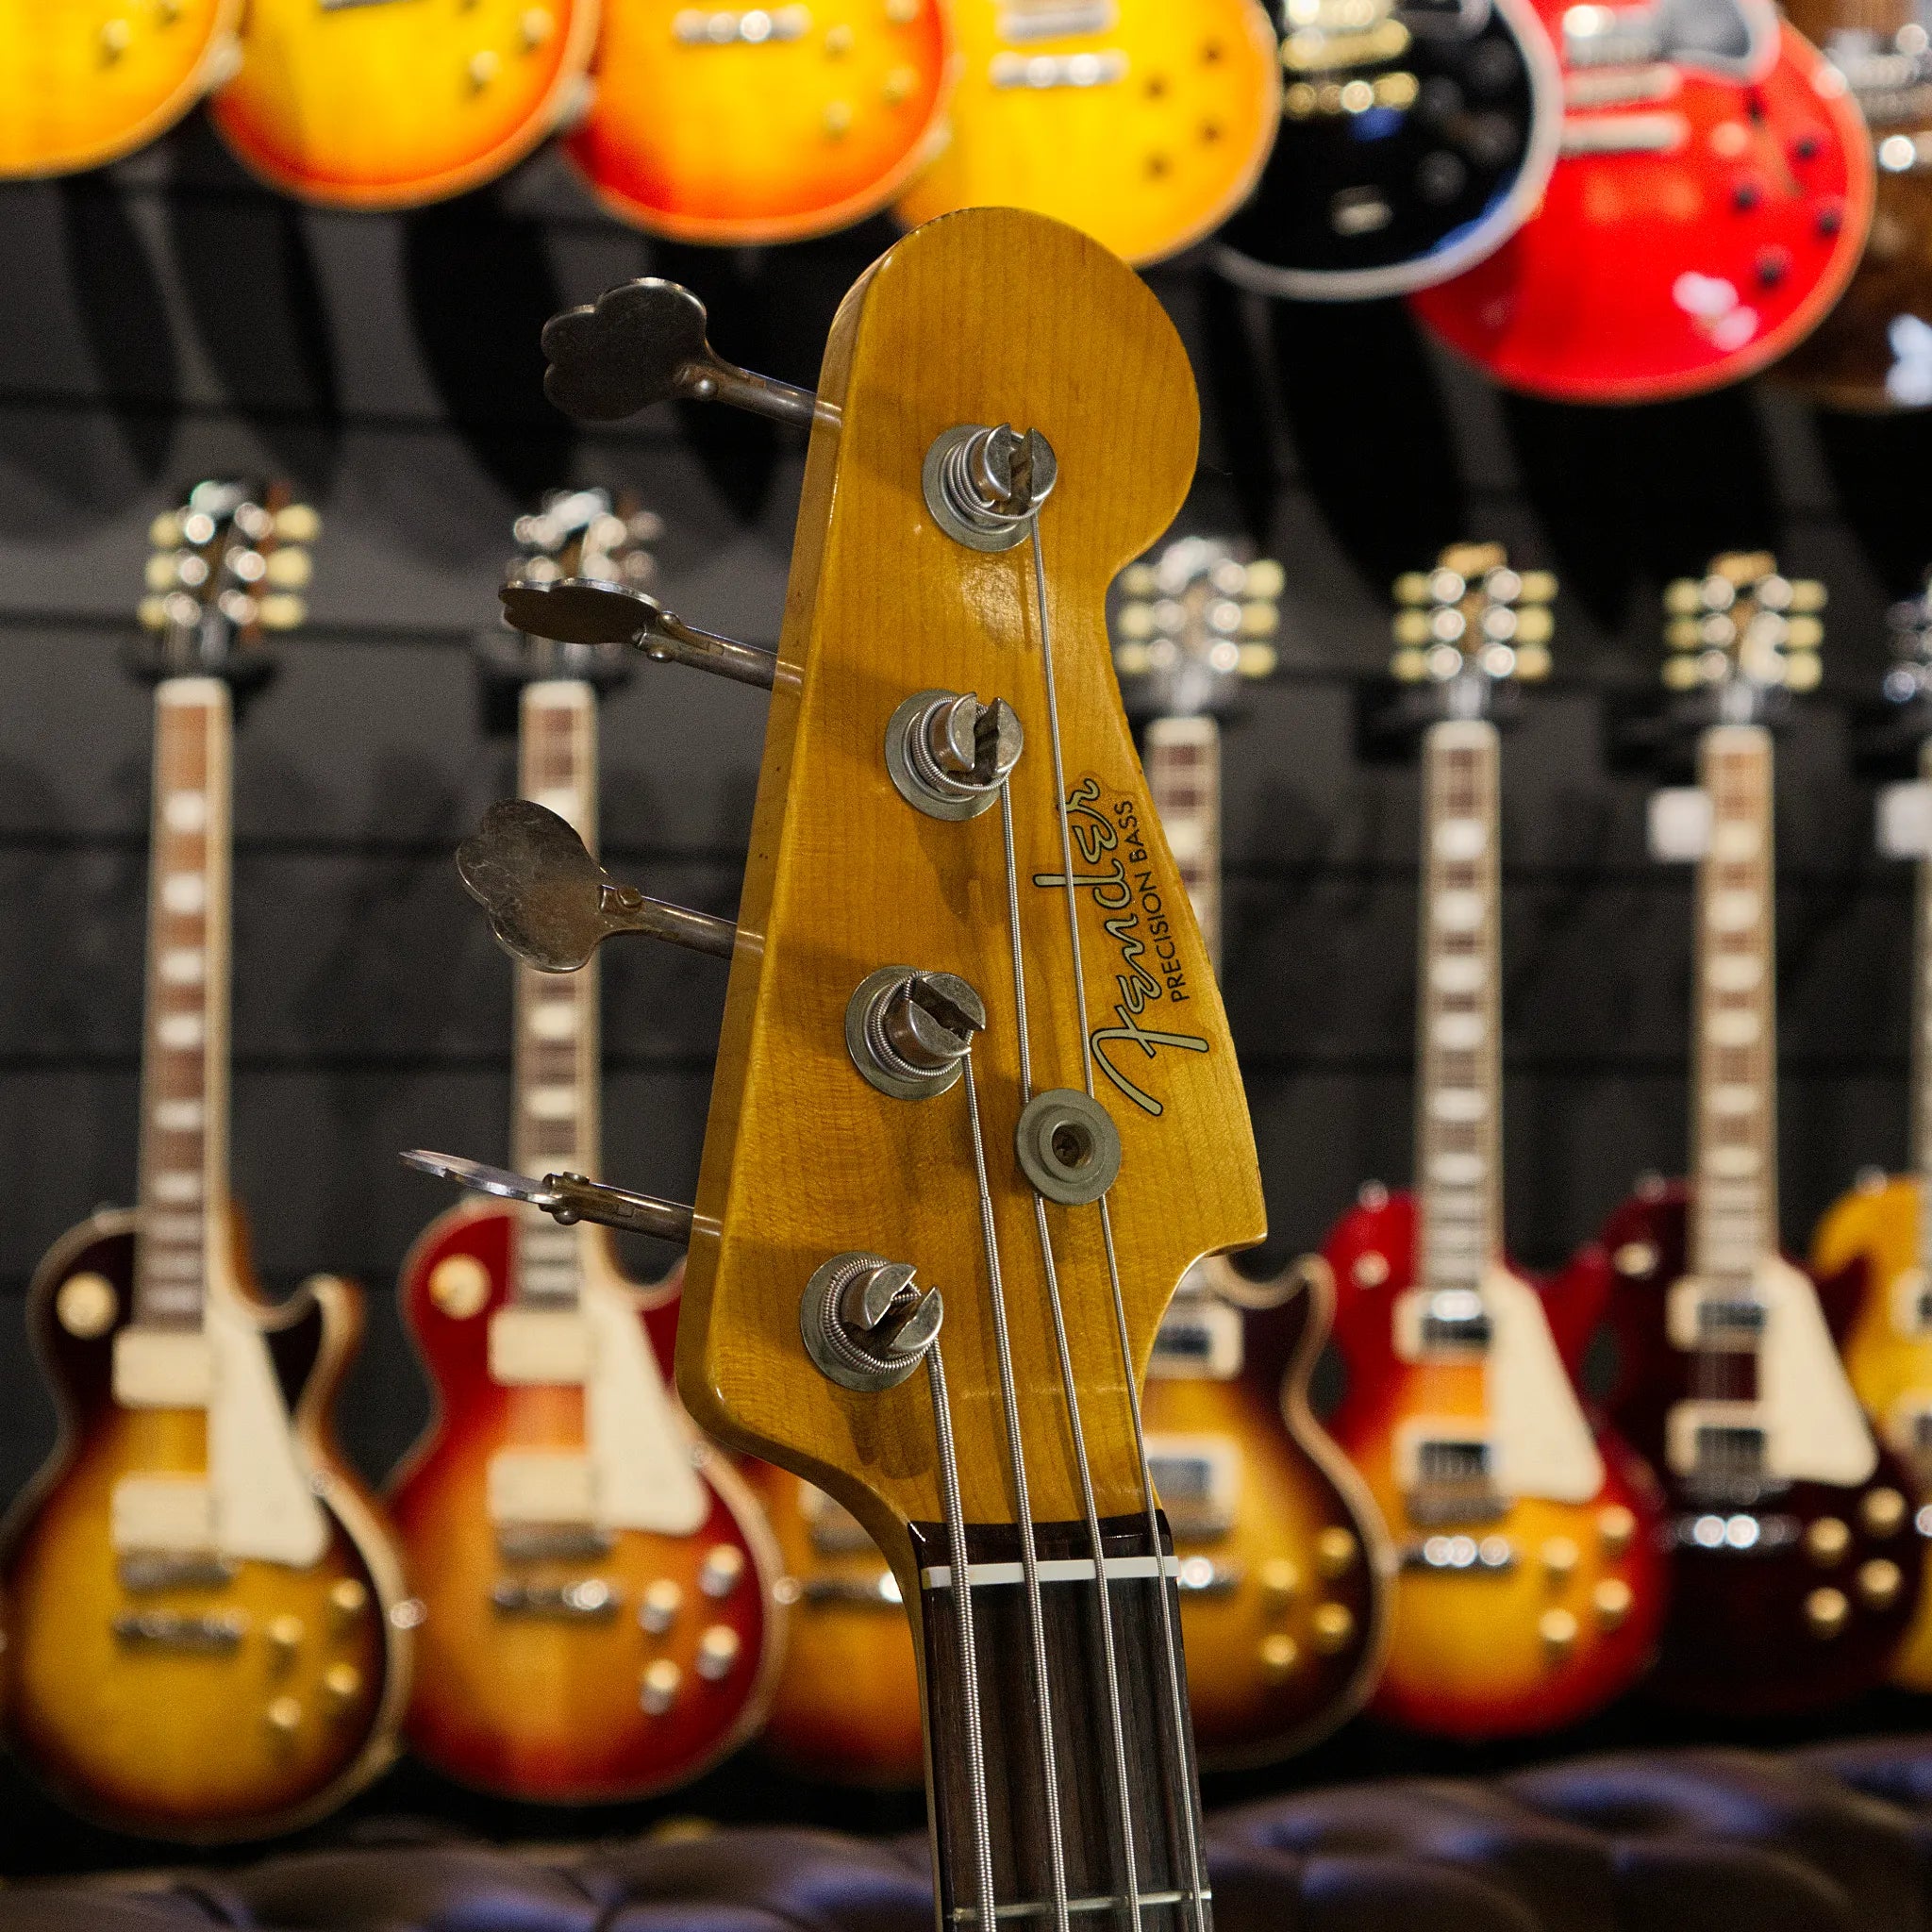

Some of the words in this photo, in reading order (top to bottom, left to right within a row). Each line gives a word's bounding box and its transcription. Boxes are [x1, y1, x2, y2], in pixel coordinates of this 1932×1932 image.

[1113, 800, 1148, 863] BASS
[1033, 777, 1208, 1116] Fender
[1134, 872, 1190, 1003] PRECISION
